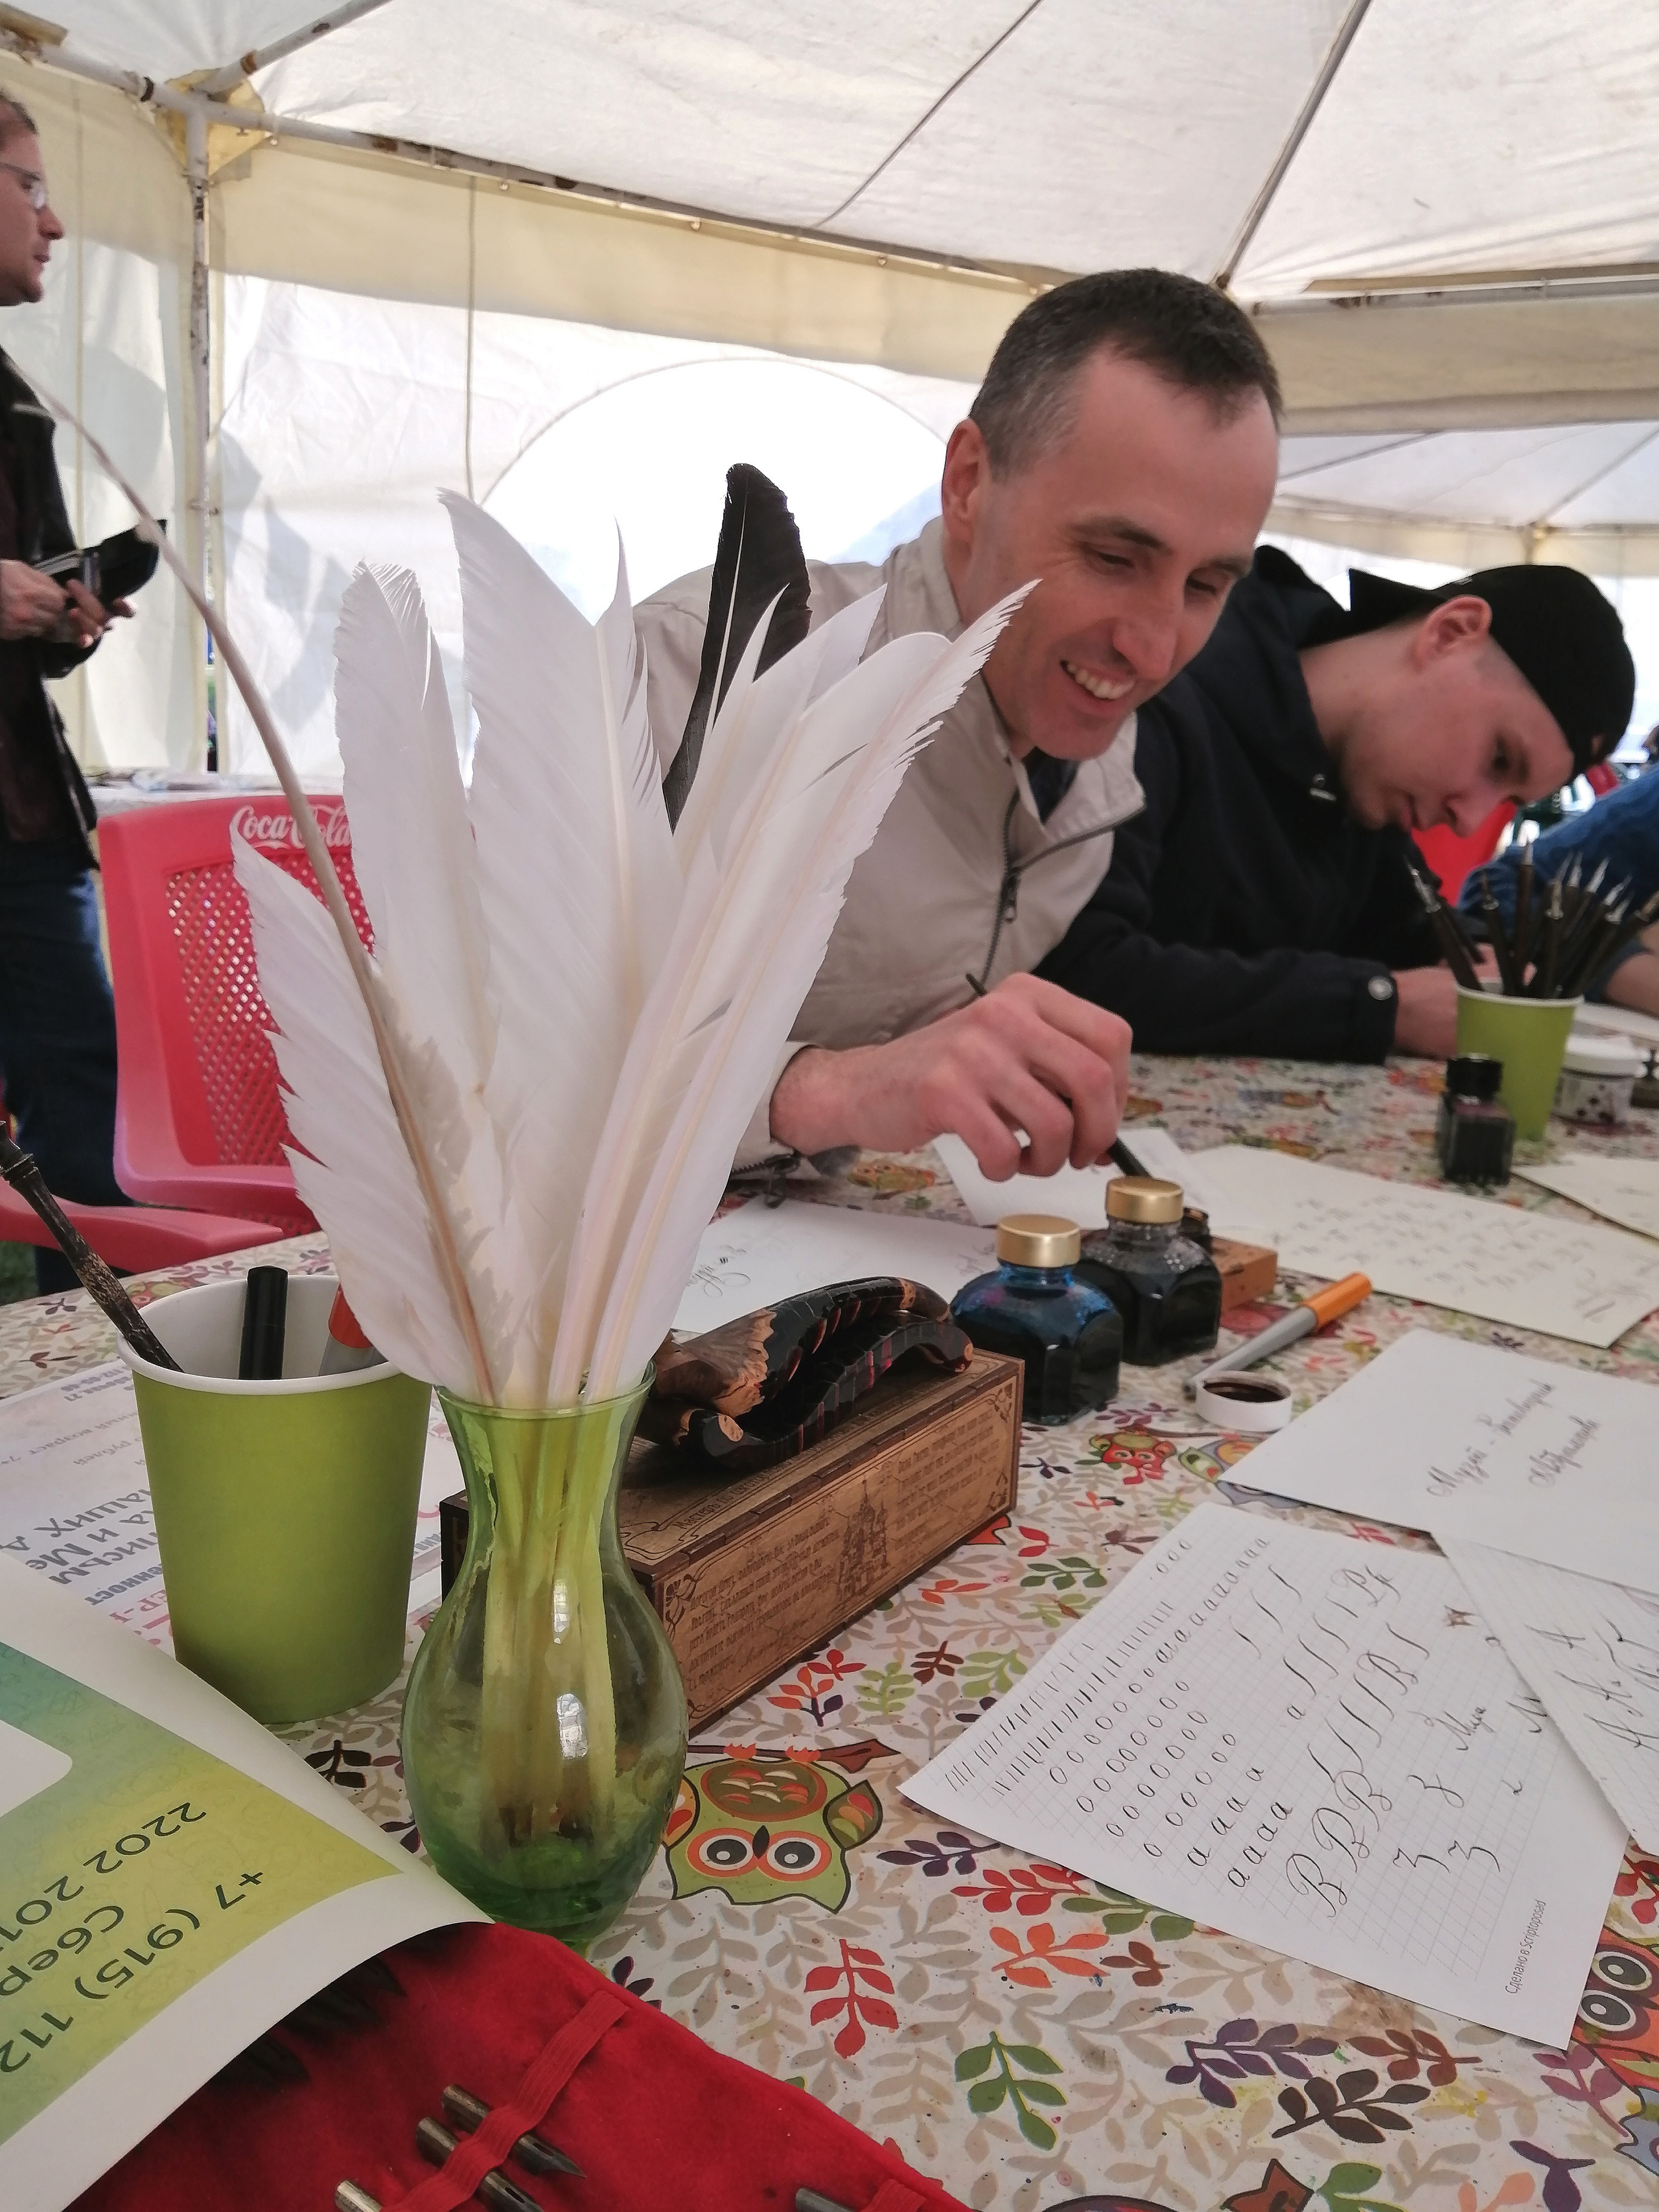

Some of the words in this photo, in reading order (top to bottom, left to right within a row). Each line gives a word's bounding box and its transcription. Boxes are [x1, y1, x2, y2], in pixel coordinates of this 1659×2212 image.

[82, 1802, 207, 1874] 2202
[215, 1871, 263, 1910] +7
[0, 1905, 124, 1996] Сбер
[74, 1908, 201, 2000] (915)
[1505, 1955, 1528, 1994] Сделано
[1519, 1899, 1546, 1950] Scriptoposad
[0, 2012, 74, 2073] 112
